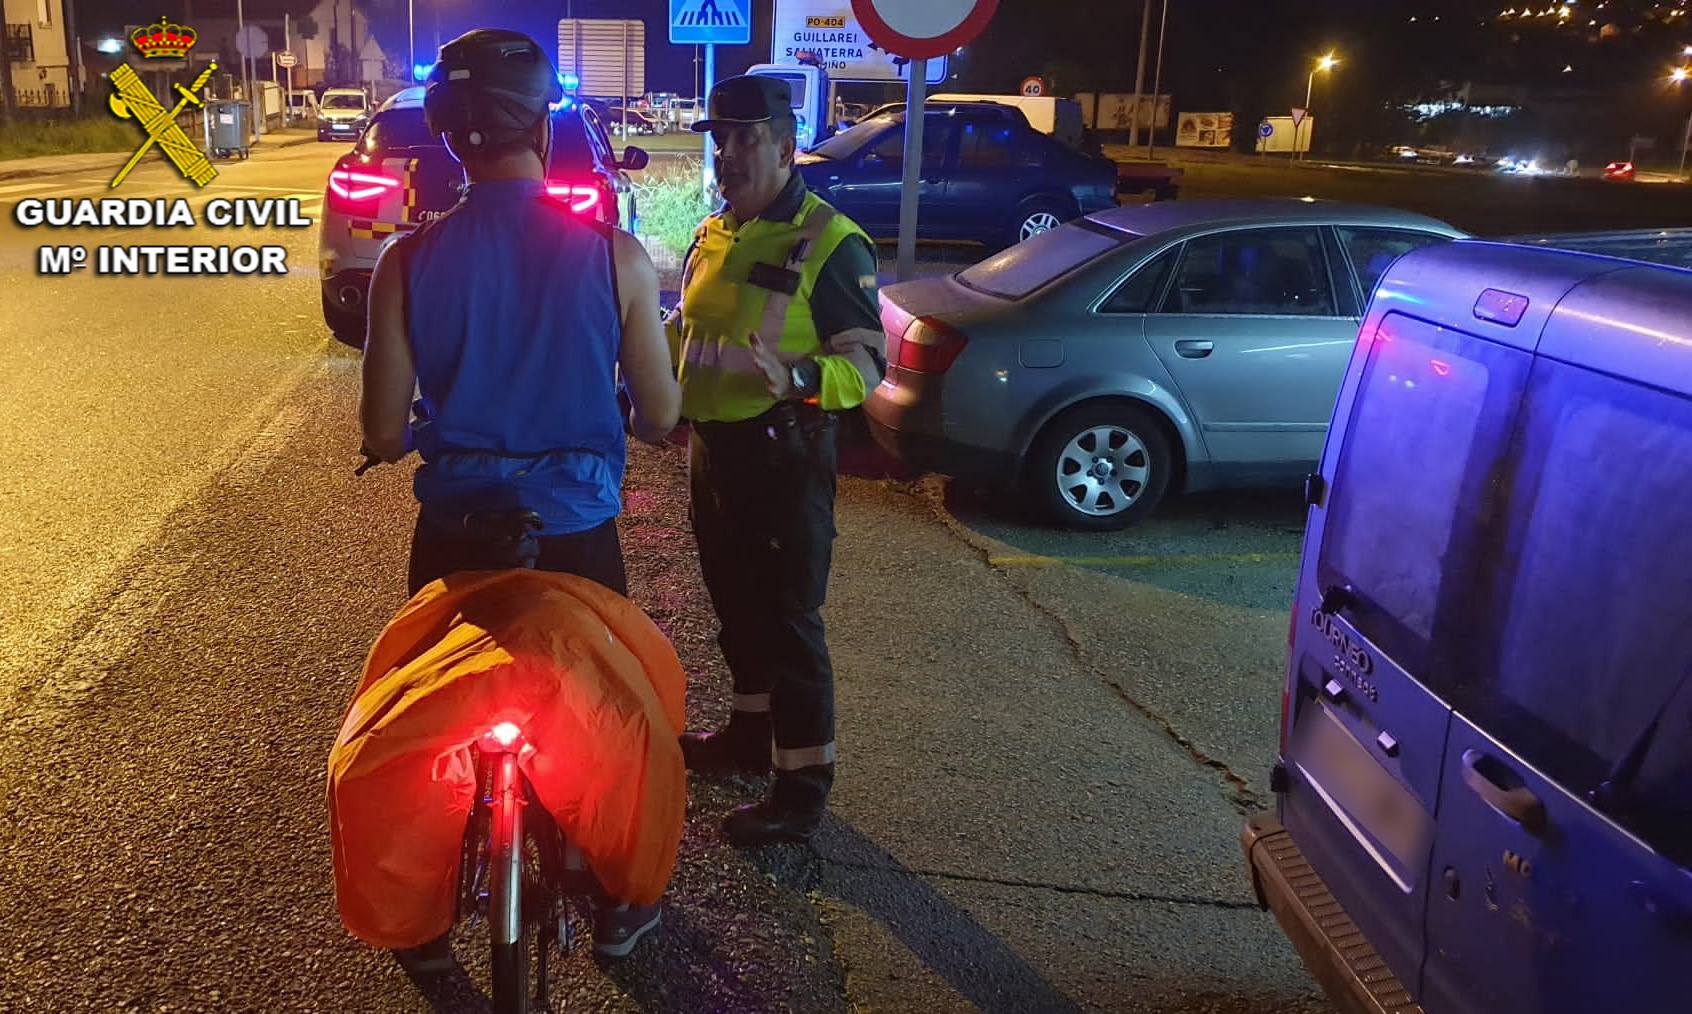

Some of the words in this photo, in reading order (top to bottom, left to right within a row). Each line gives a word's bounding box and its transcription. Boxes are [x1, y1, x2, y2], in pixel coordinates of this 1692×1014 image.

[807, 18, 844, 27] PO-404
[794, 32, 857, 43] GUILLAREI
[1025, 85, 1040, 94] 40
[1311, 606, 1371, 671] TOURNEO
